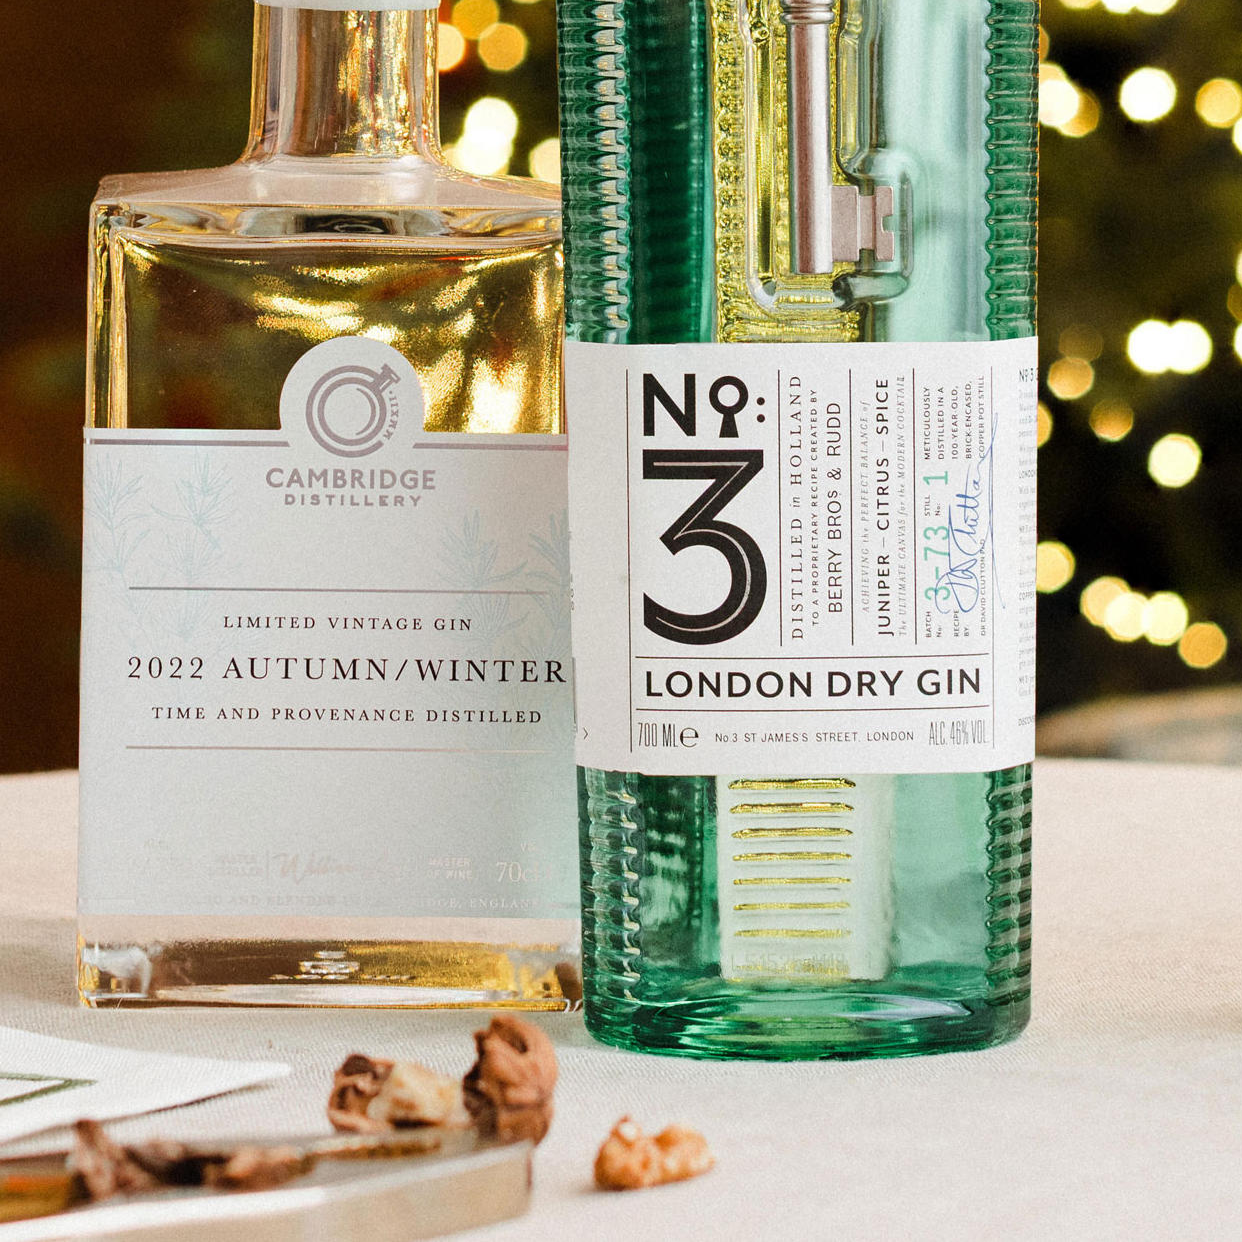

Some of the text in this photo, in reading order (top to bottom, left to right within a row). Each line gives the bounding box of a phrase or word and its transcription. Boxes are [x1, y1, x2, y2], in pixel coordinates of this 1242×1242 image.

[810, 390, 817, 403] BY
[938, 397, 944, 406] IN
[826, 403, 841, 456] RUDD
[897, 434, 905, 479] MODERN
[266, 468, 436, 490] CAMBRIDGE
[827, 468, 841, 480] &
[922, 470, 949, 486] 1
[285, 494, 421, 507] DISTILLERY
[897, 484, 905, 497] the
[789, 376, 803, 639] DISTILLED in HOLLAND
[860, 400, 871, 612] ACHIEVING the PERFECT BALANCE of
[876, 380, 894, 636] JUNIPER CITRUS SPICE
[897, 501, 908, 516] for
[642, 449, 768, 646] 3
[898, 520, 906, 559] CANVAS
[828, 549, 842, 612] BERRY
[898, 565, 906, 615] ULTIMATE
[224, 616, 471, 630] LIMITED VINTAGE GIN
[812, 612, 819, 626] TO
[898, 621, 907, 636] The
[128, 657, 566, 683] 2022 AUTUMN/WINTER
[646, 668, 980, 698] LONDON DRY GIN
[152, 707, 541, 723] TIME AND PROVENANCE DISTILLED
[638, 722, 657, 747] 700
[744, 733, 756, 742] ST
[867, 731, 913, 741] LONDON
